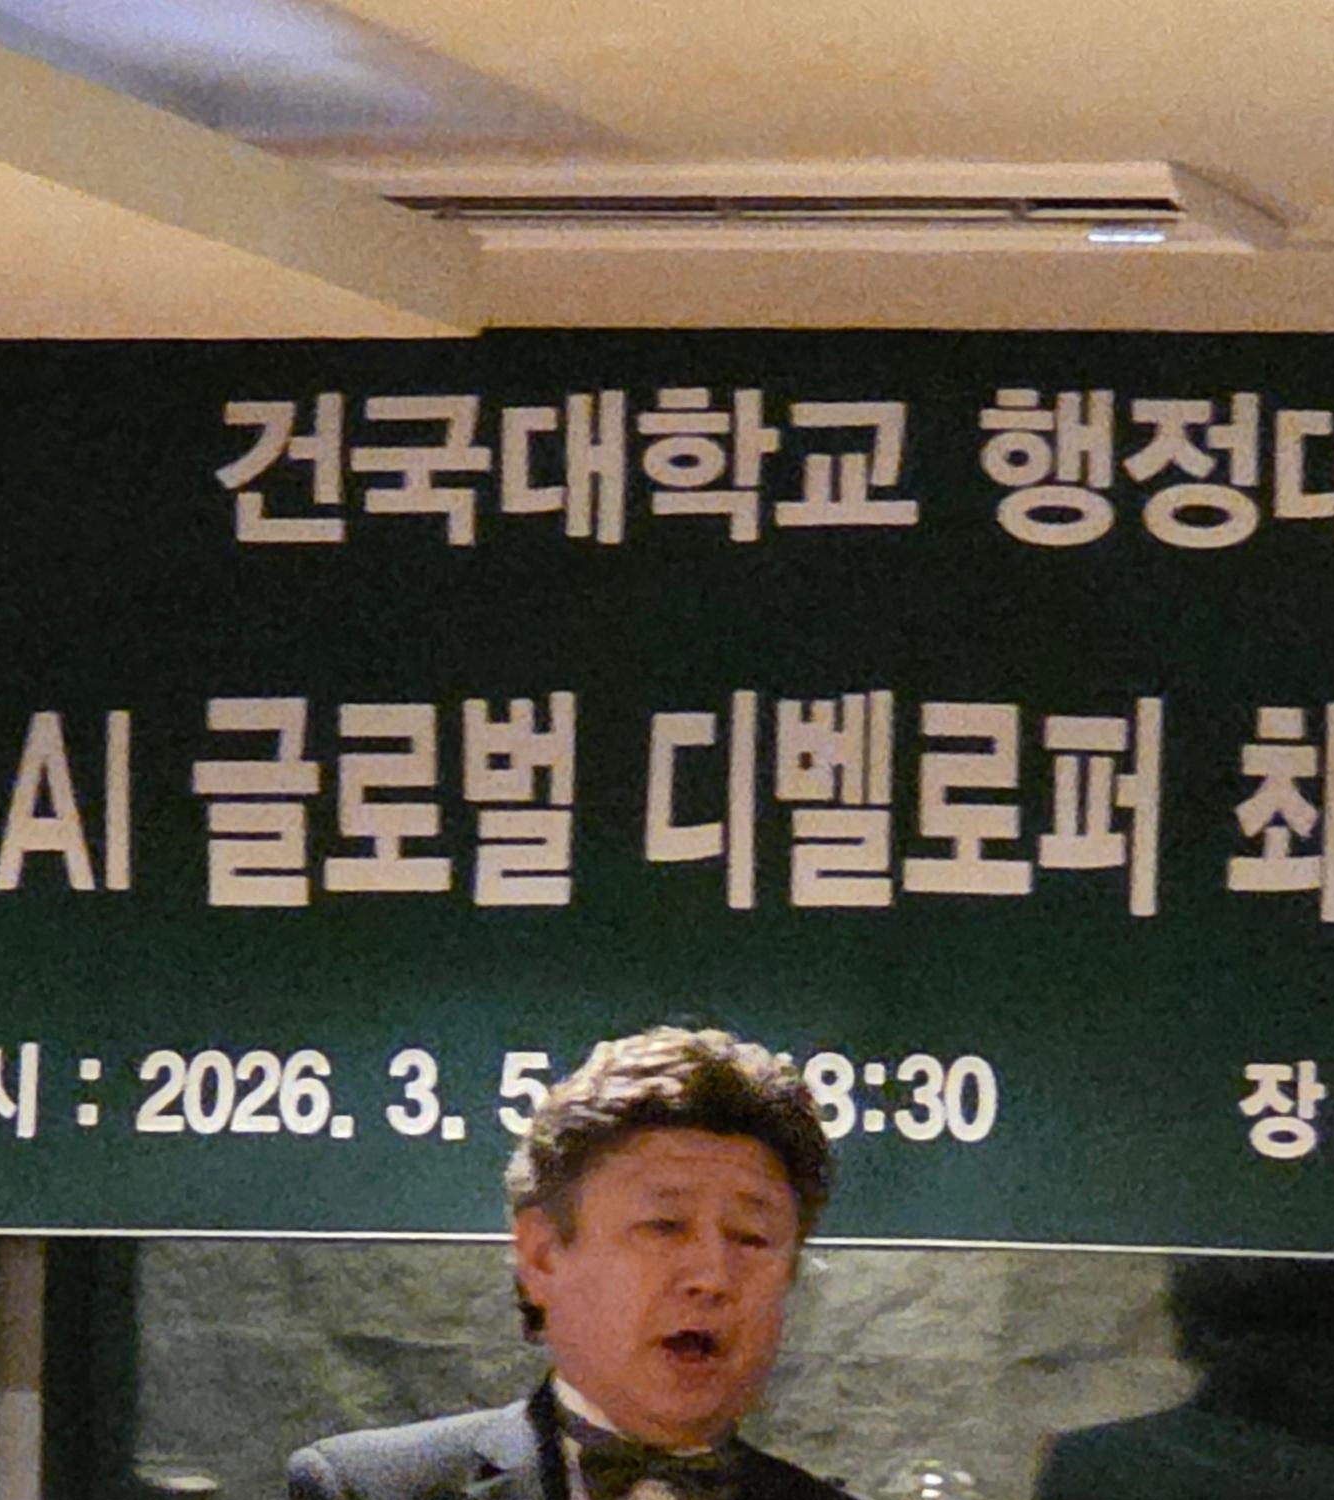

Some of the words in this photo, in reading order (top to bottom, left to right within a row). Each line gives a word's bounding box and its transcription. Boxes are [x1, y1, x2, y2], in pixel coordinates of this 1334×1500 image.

[216, 387, 919, 545] 건국대학교
[192, 691, 576, 907] 글로벌
[645, 689, 1163, 917] 디벨로퍼
[134, 1049, 357, 1140] 2026.
[384, 1048, 467, 1142] 3.
[497, 1050, 553, 1137] 5
[801, 1050, 999, 1143] 8:30
